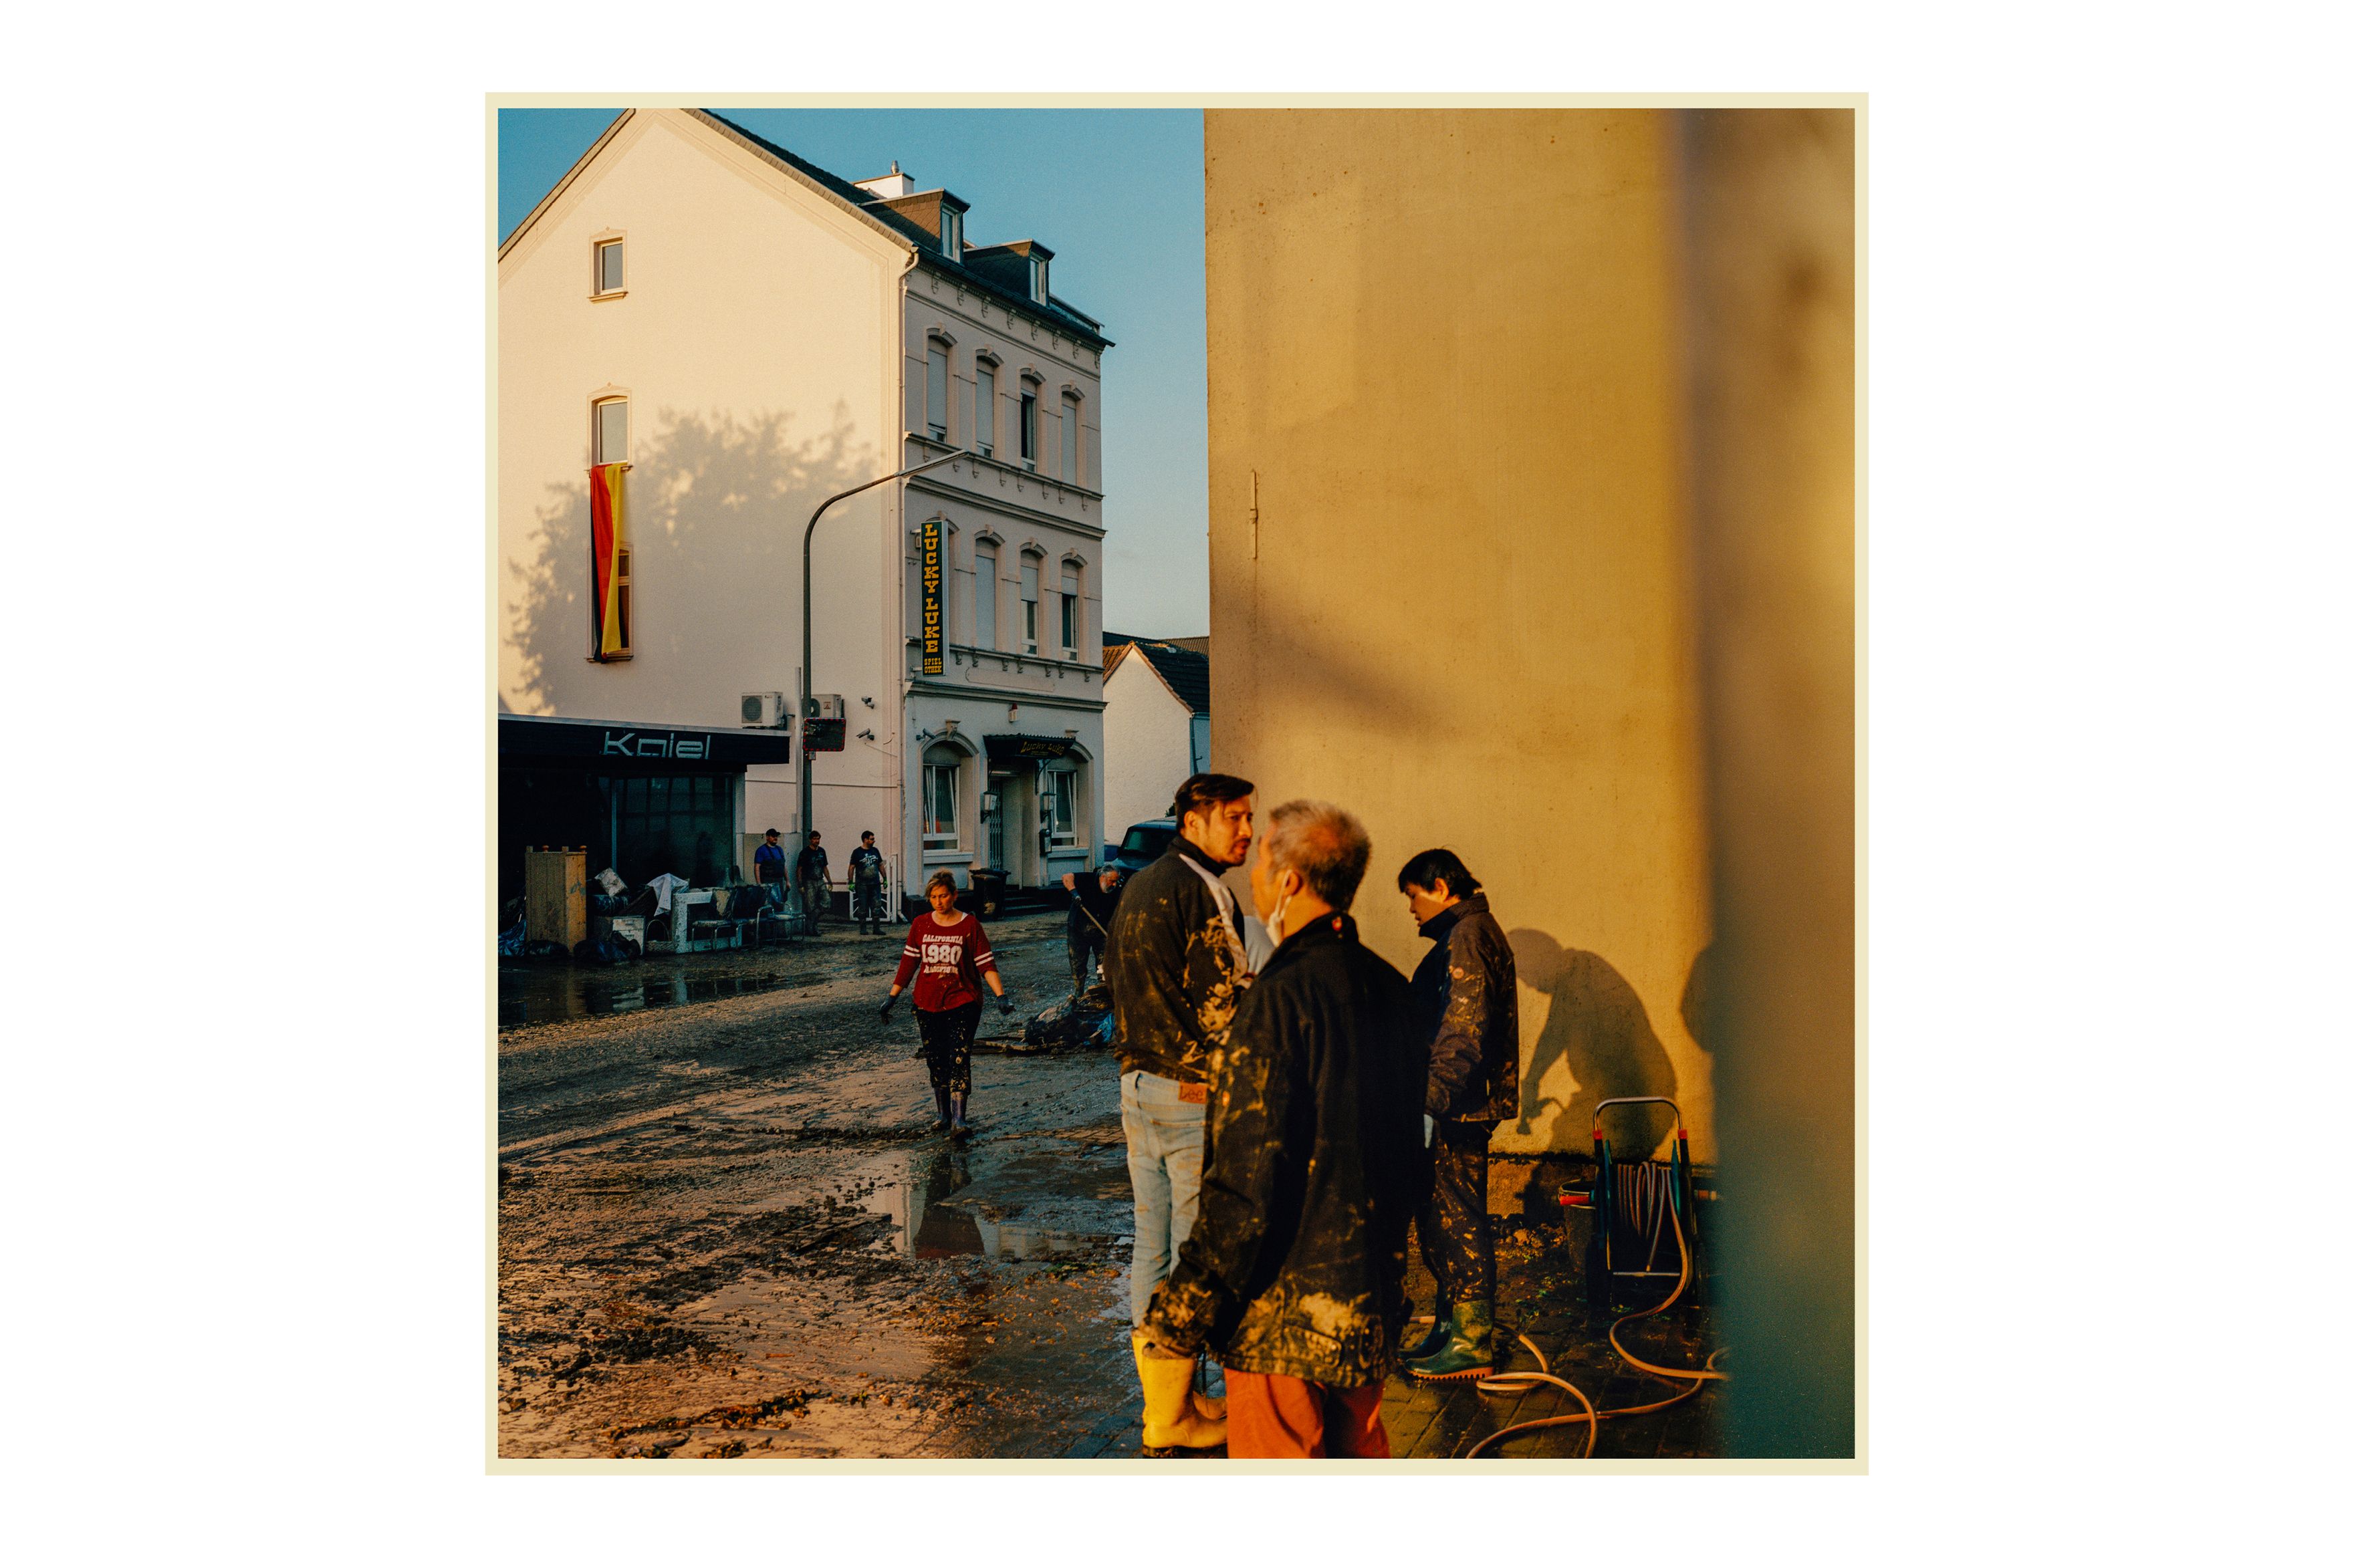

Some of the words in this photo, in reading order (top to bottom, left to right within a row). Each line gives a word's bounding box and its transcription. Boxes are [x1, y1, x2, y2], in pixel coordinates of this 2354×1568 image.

[924, 524, 939, 594] LUCKY
[925, 598, 940, 653] LUKE
[924, 658, 942, 666] SPIEL
[923, 934, 963, 944] CALIFORNIA
[921, 944, 962, 964] 1980
[1179, 1085, 1203, 1101] Lee
